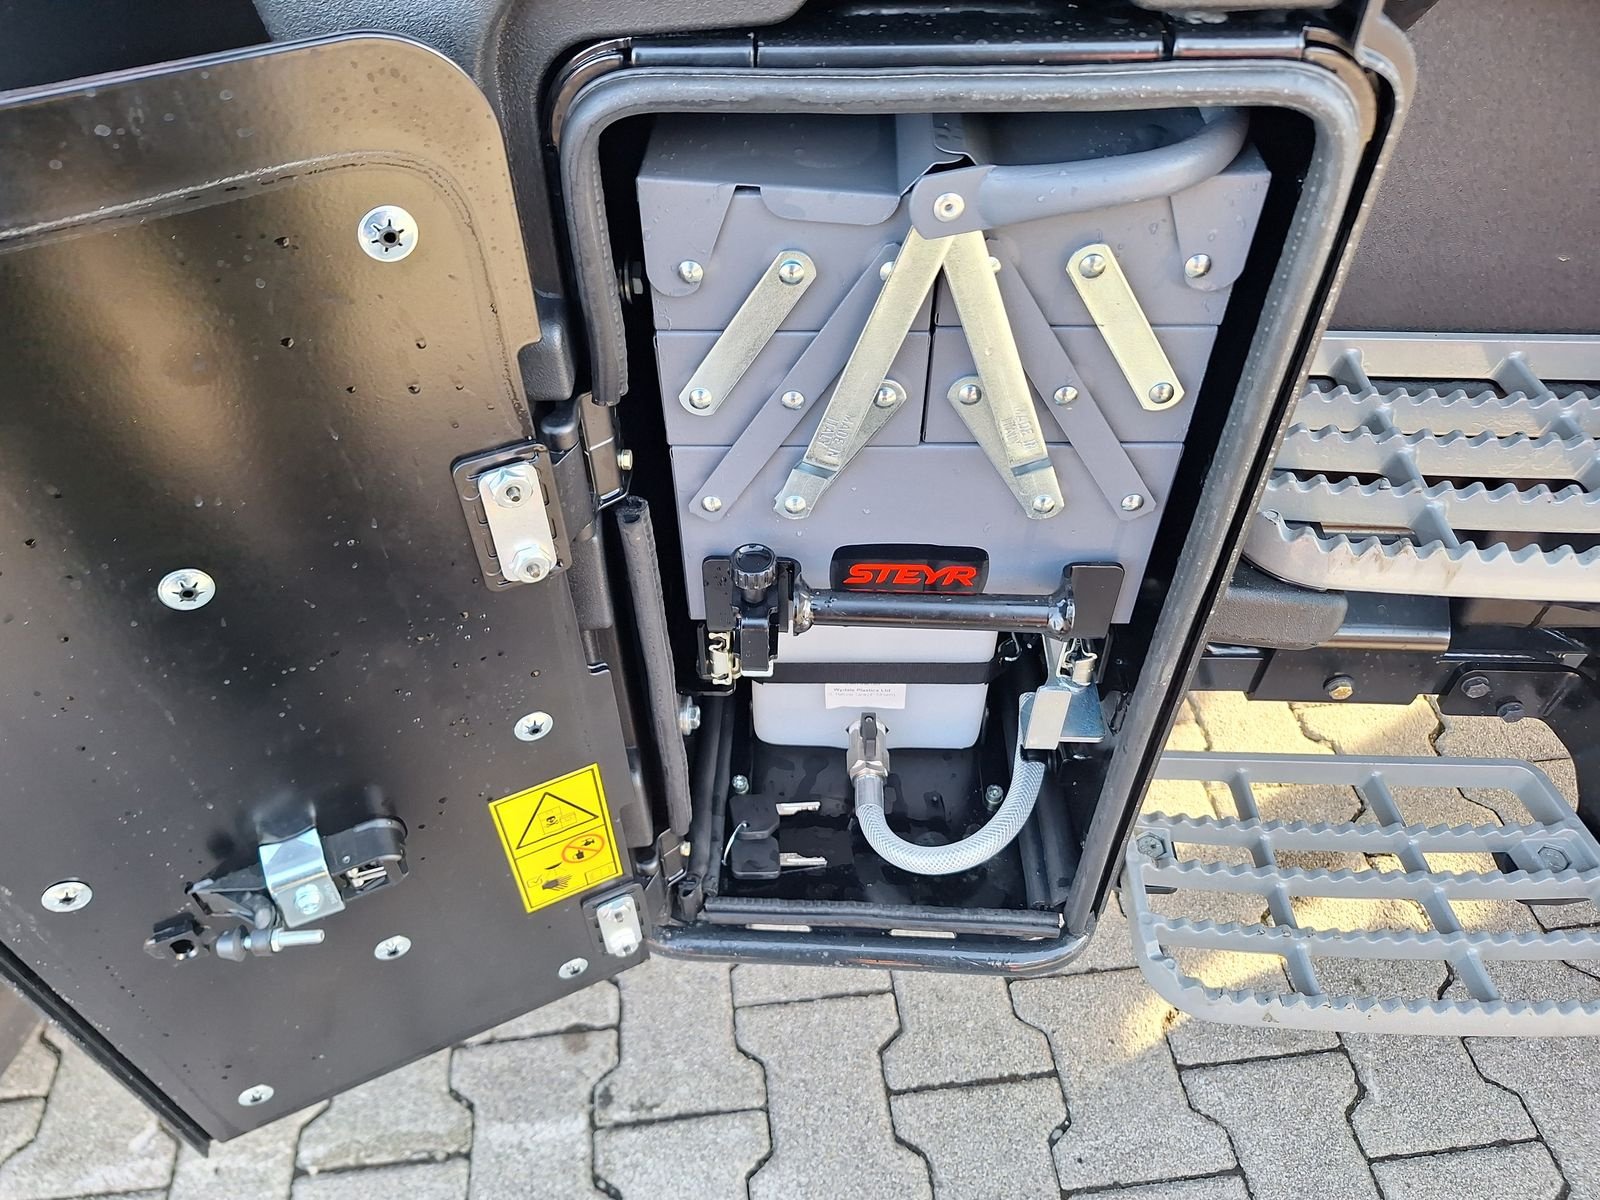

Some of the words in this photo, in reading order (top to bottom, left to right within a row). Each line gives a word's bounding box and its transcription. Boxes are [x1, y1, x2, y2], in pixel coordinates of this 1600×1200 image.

[816, 417, 840, 448] ITALY
[833, 414, 857, 446] MADE
[1000, 416, 1022, 449] ITALY
[1013, 405, 1034, 438] MADE
[825, 447, 843, 459] IN
[1022, 438, 1040, 451] IN
[843, 563, 977, 586] STEYR
